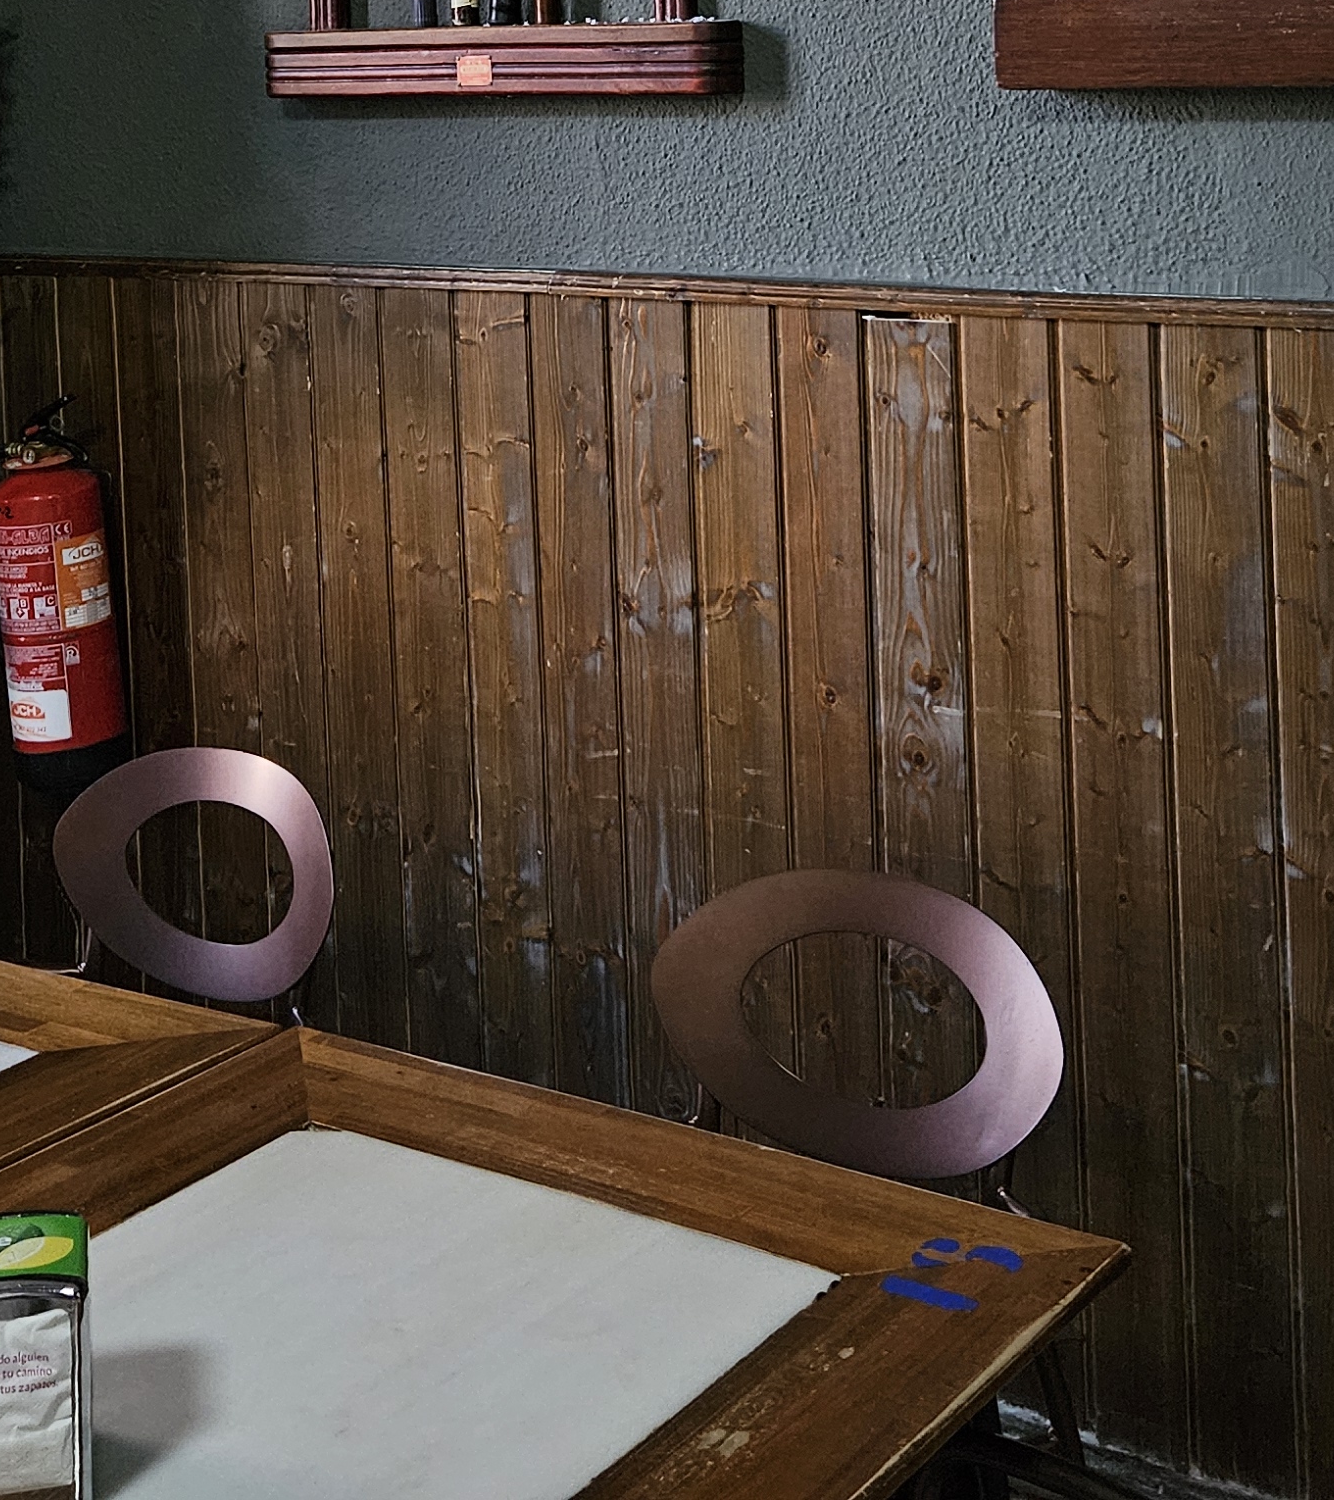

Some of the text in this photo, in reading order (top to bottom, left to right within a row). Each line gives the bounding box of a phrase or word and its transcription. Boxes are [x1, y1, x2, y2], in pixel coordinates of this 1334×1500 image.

[7, 545, 49, 557] INCENDIOS
[72, 543, 100, 560] JCH
[46, 596, 55, 605] C
[13, 704, 37, 716] JCH
[12, 1351, 50, 1365] alguien
[2, 1370, 14, 1379] tu
[16, 1366, 53, 1377] camino
[0, 1385, 16, 1394] tus
